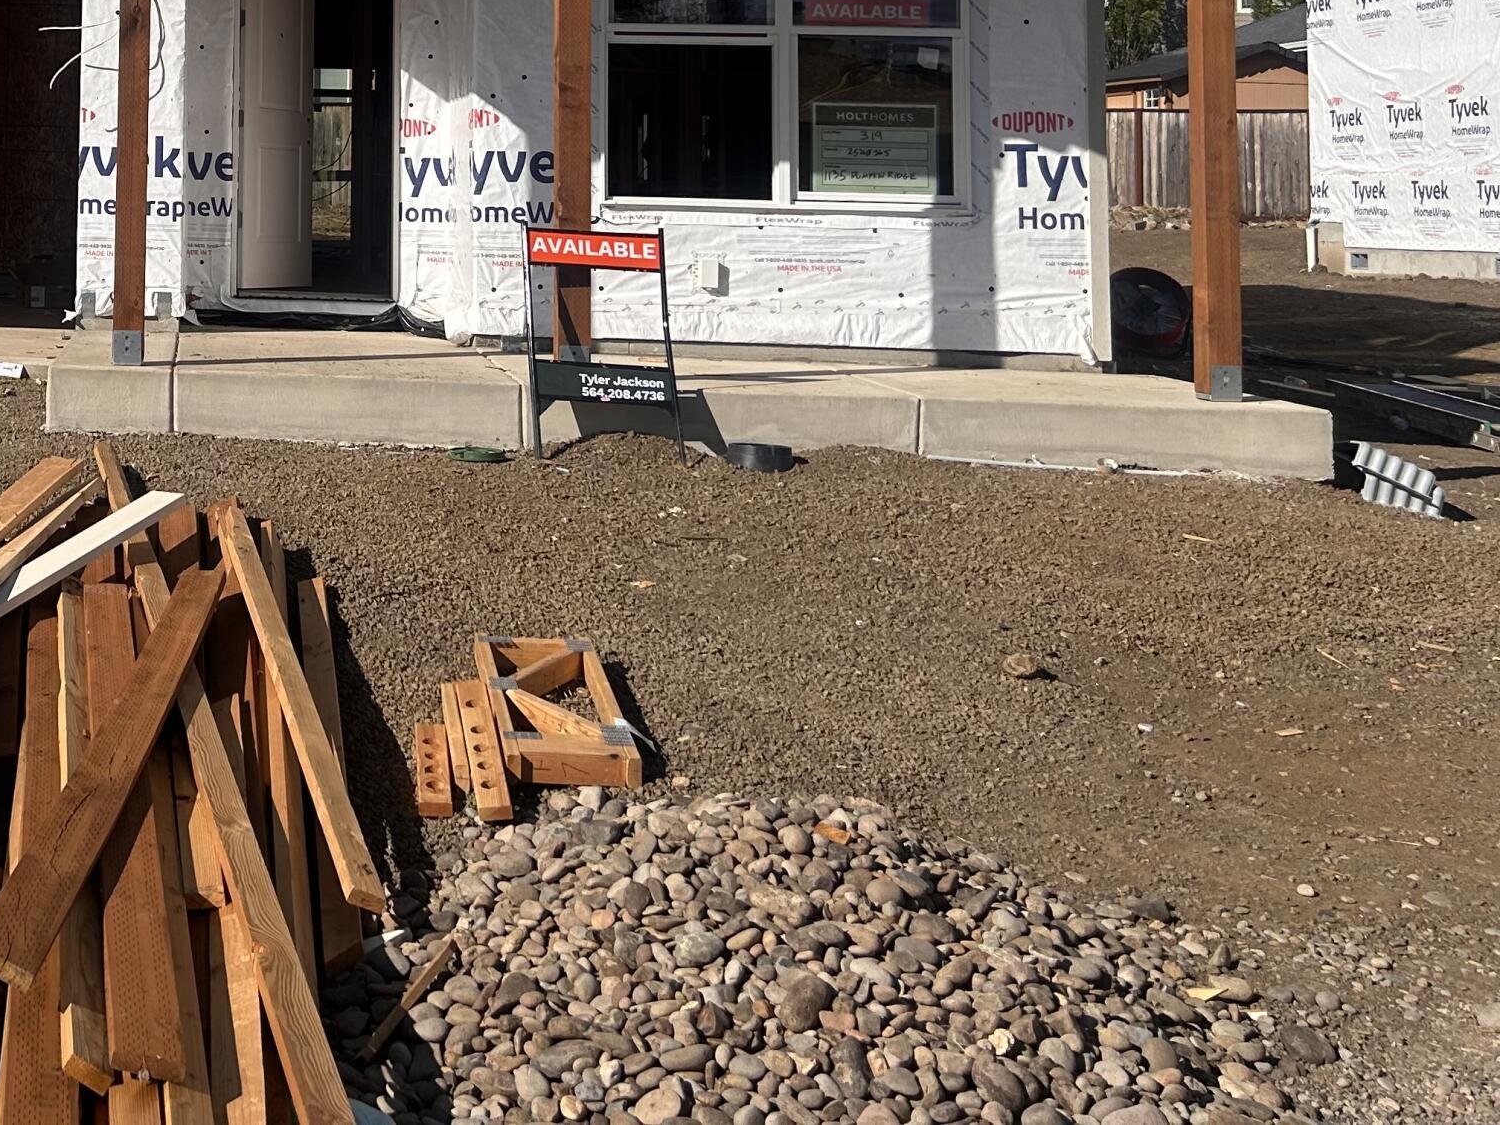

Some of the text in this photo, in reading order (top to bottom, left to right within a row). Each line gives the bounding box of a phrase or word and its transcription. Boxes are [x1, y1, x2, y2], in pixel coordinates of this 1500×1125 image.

[812, 3, 921, 20] AVAILABLE
[1357, 9, 1391, 22] HomeWrap
[1387, 102, 1423, 128] Tyvek
[1449, 96, 1489, 123] Tyvek
[1002, 111, 1065, 133] DUPONT
[1330, 107, 1363, 131] Tyvek
[1389, 130, 1424, 142] HomeWrap
[1452, 125, 1491, 136] HomeWrap
[1352, 180, 1386, 204] Tyvek
[1411, 179, 1449, 204] Tyvek
[755, 216, 824, 225] FlexWrap
[1018, 207, 1085, 230] Hom
[85, 249, 114, 257] MADE IN
[532, 236, 657, 260] AVAILABLE
[492, 260, 524, 269] MADE IN
[777, 265, 842, 273] MADE IN THE USA
[578, 373, 665, 389] Tyler Jackson
[581, 387, 665, 402] 564.208.4736
